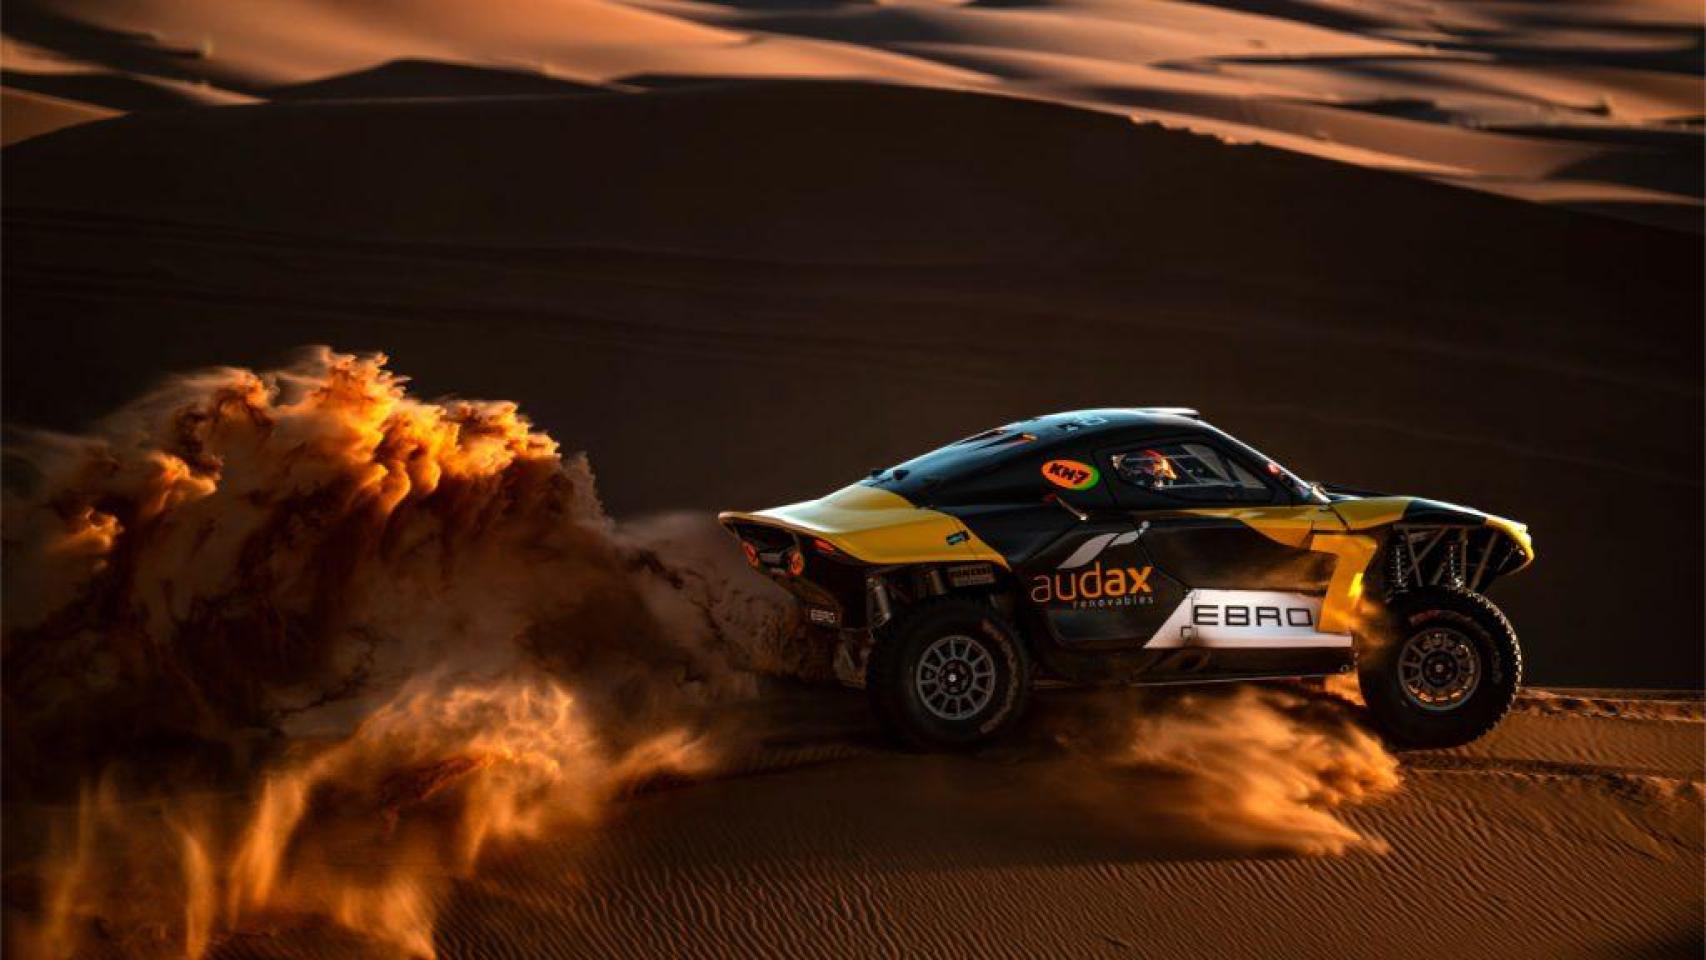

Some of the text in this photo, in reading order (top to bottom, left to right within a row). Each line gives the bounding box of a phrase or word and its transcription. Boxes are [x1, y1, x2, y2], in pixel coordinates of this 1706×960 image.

[1031, 561, 1152, 602] audax
[1073, 595, 1154, 608] renovables
[1193, 605, 1313, 627] EBRO
